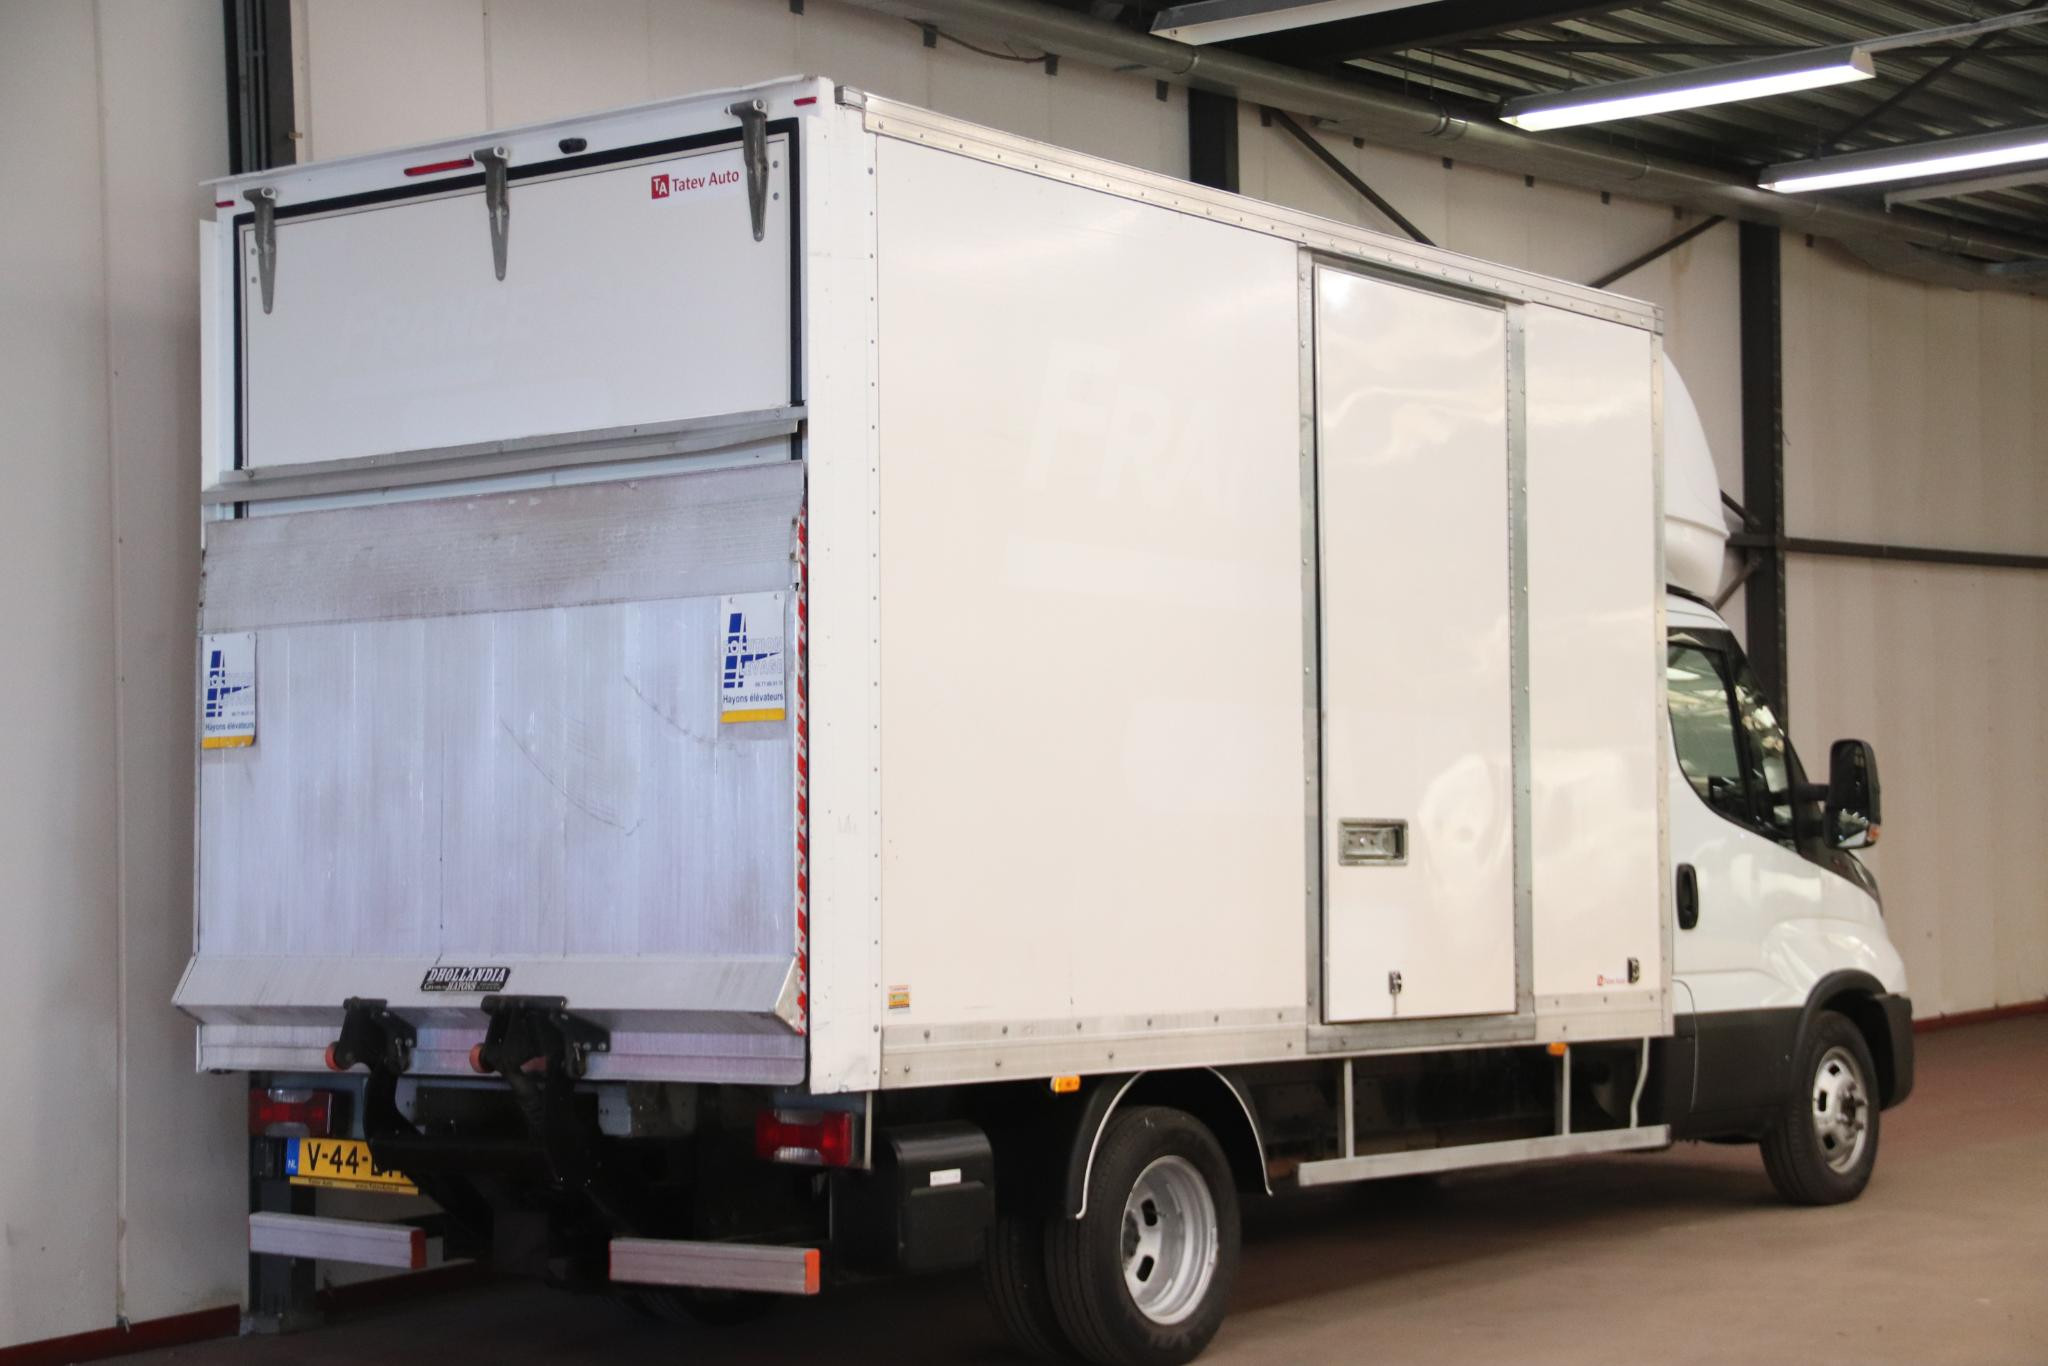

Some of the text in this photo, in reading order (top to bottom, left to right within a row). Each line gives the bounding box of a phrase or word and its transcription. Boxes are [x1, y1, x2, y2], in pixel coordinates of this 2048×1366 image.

[672, 170, 740, 192] Tatev Auto
[723, 694, 748, 704] Hayons
[427, 967, 507, 981] DHOLLANDIA
[287, 1159, 297, 1169] NL
